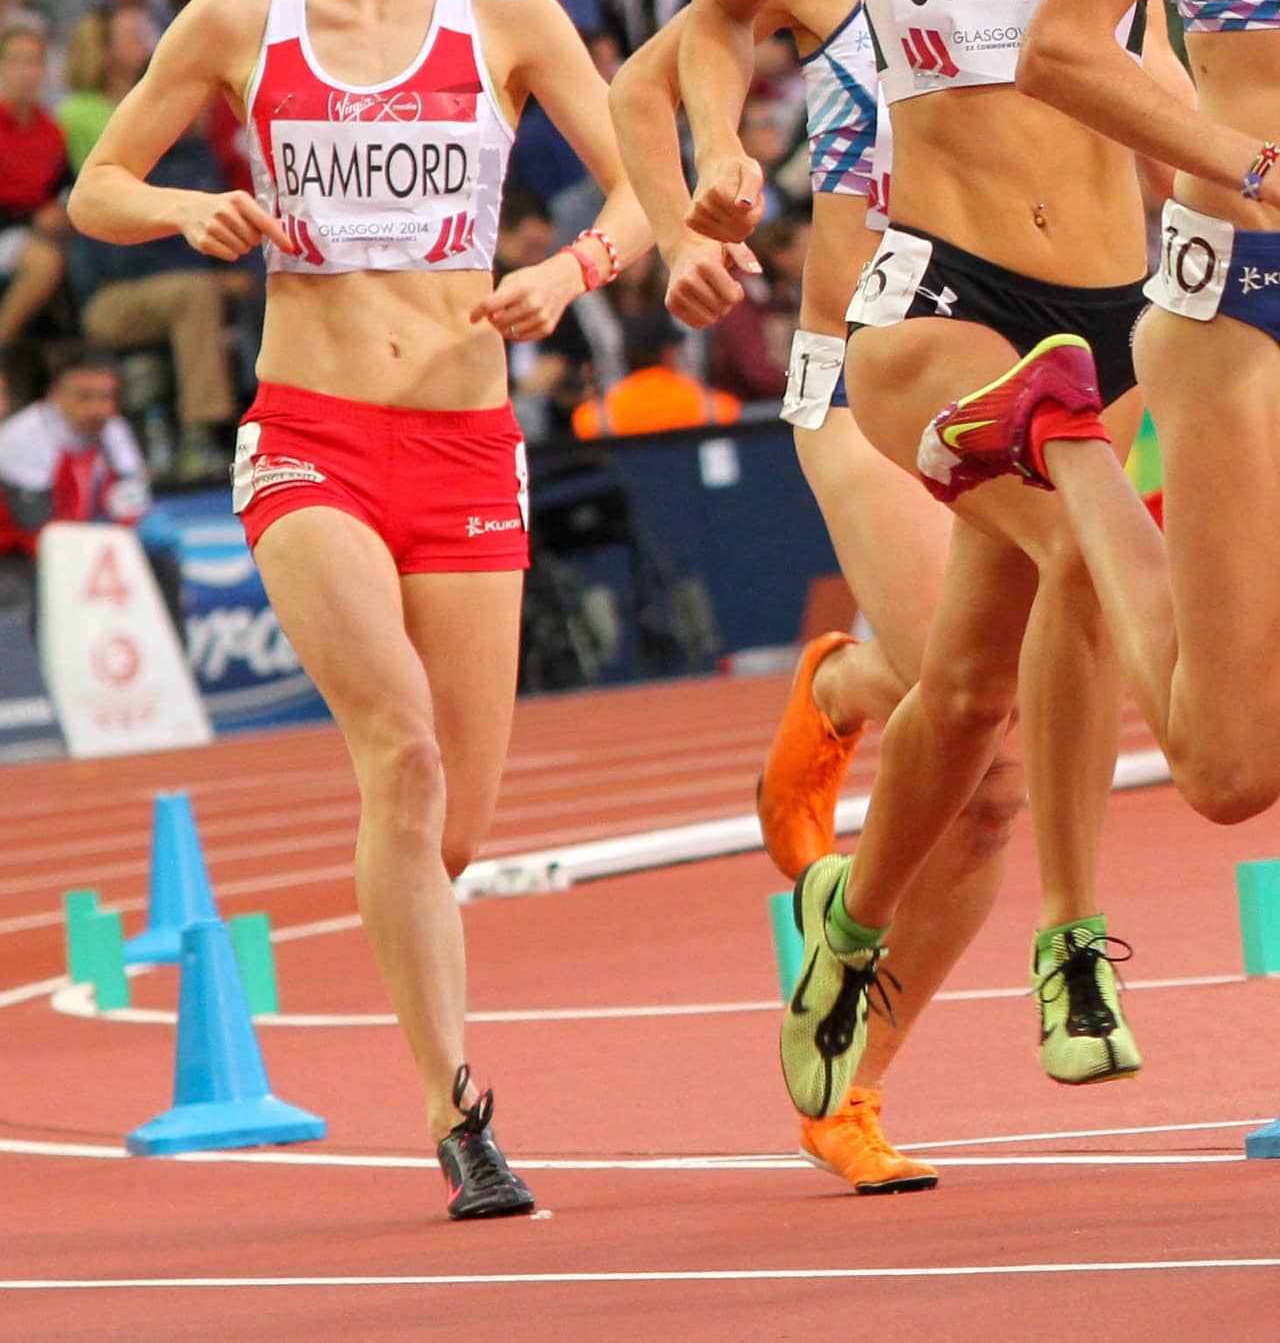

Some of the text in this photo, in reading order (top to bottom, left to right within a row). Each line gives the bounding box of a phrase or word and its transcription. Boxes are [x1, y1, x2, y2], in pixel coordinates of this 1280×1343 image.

[334, 93, 376, 123] Virgin
[282, 141, 468, 198] BAMFORD
[317, 222, 430, 238] GLASGOW 2014
[862, 251, 895, 303] 6
[1165, 225, 1216, 294] 10
[485, 519, 521, 531] KUKR
[82, 544, 129, 606] 4
